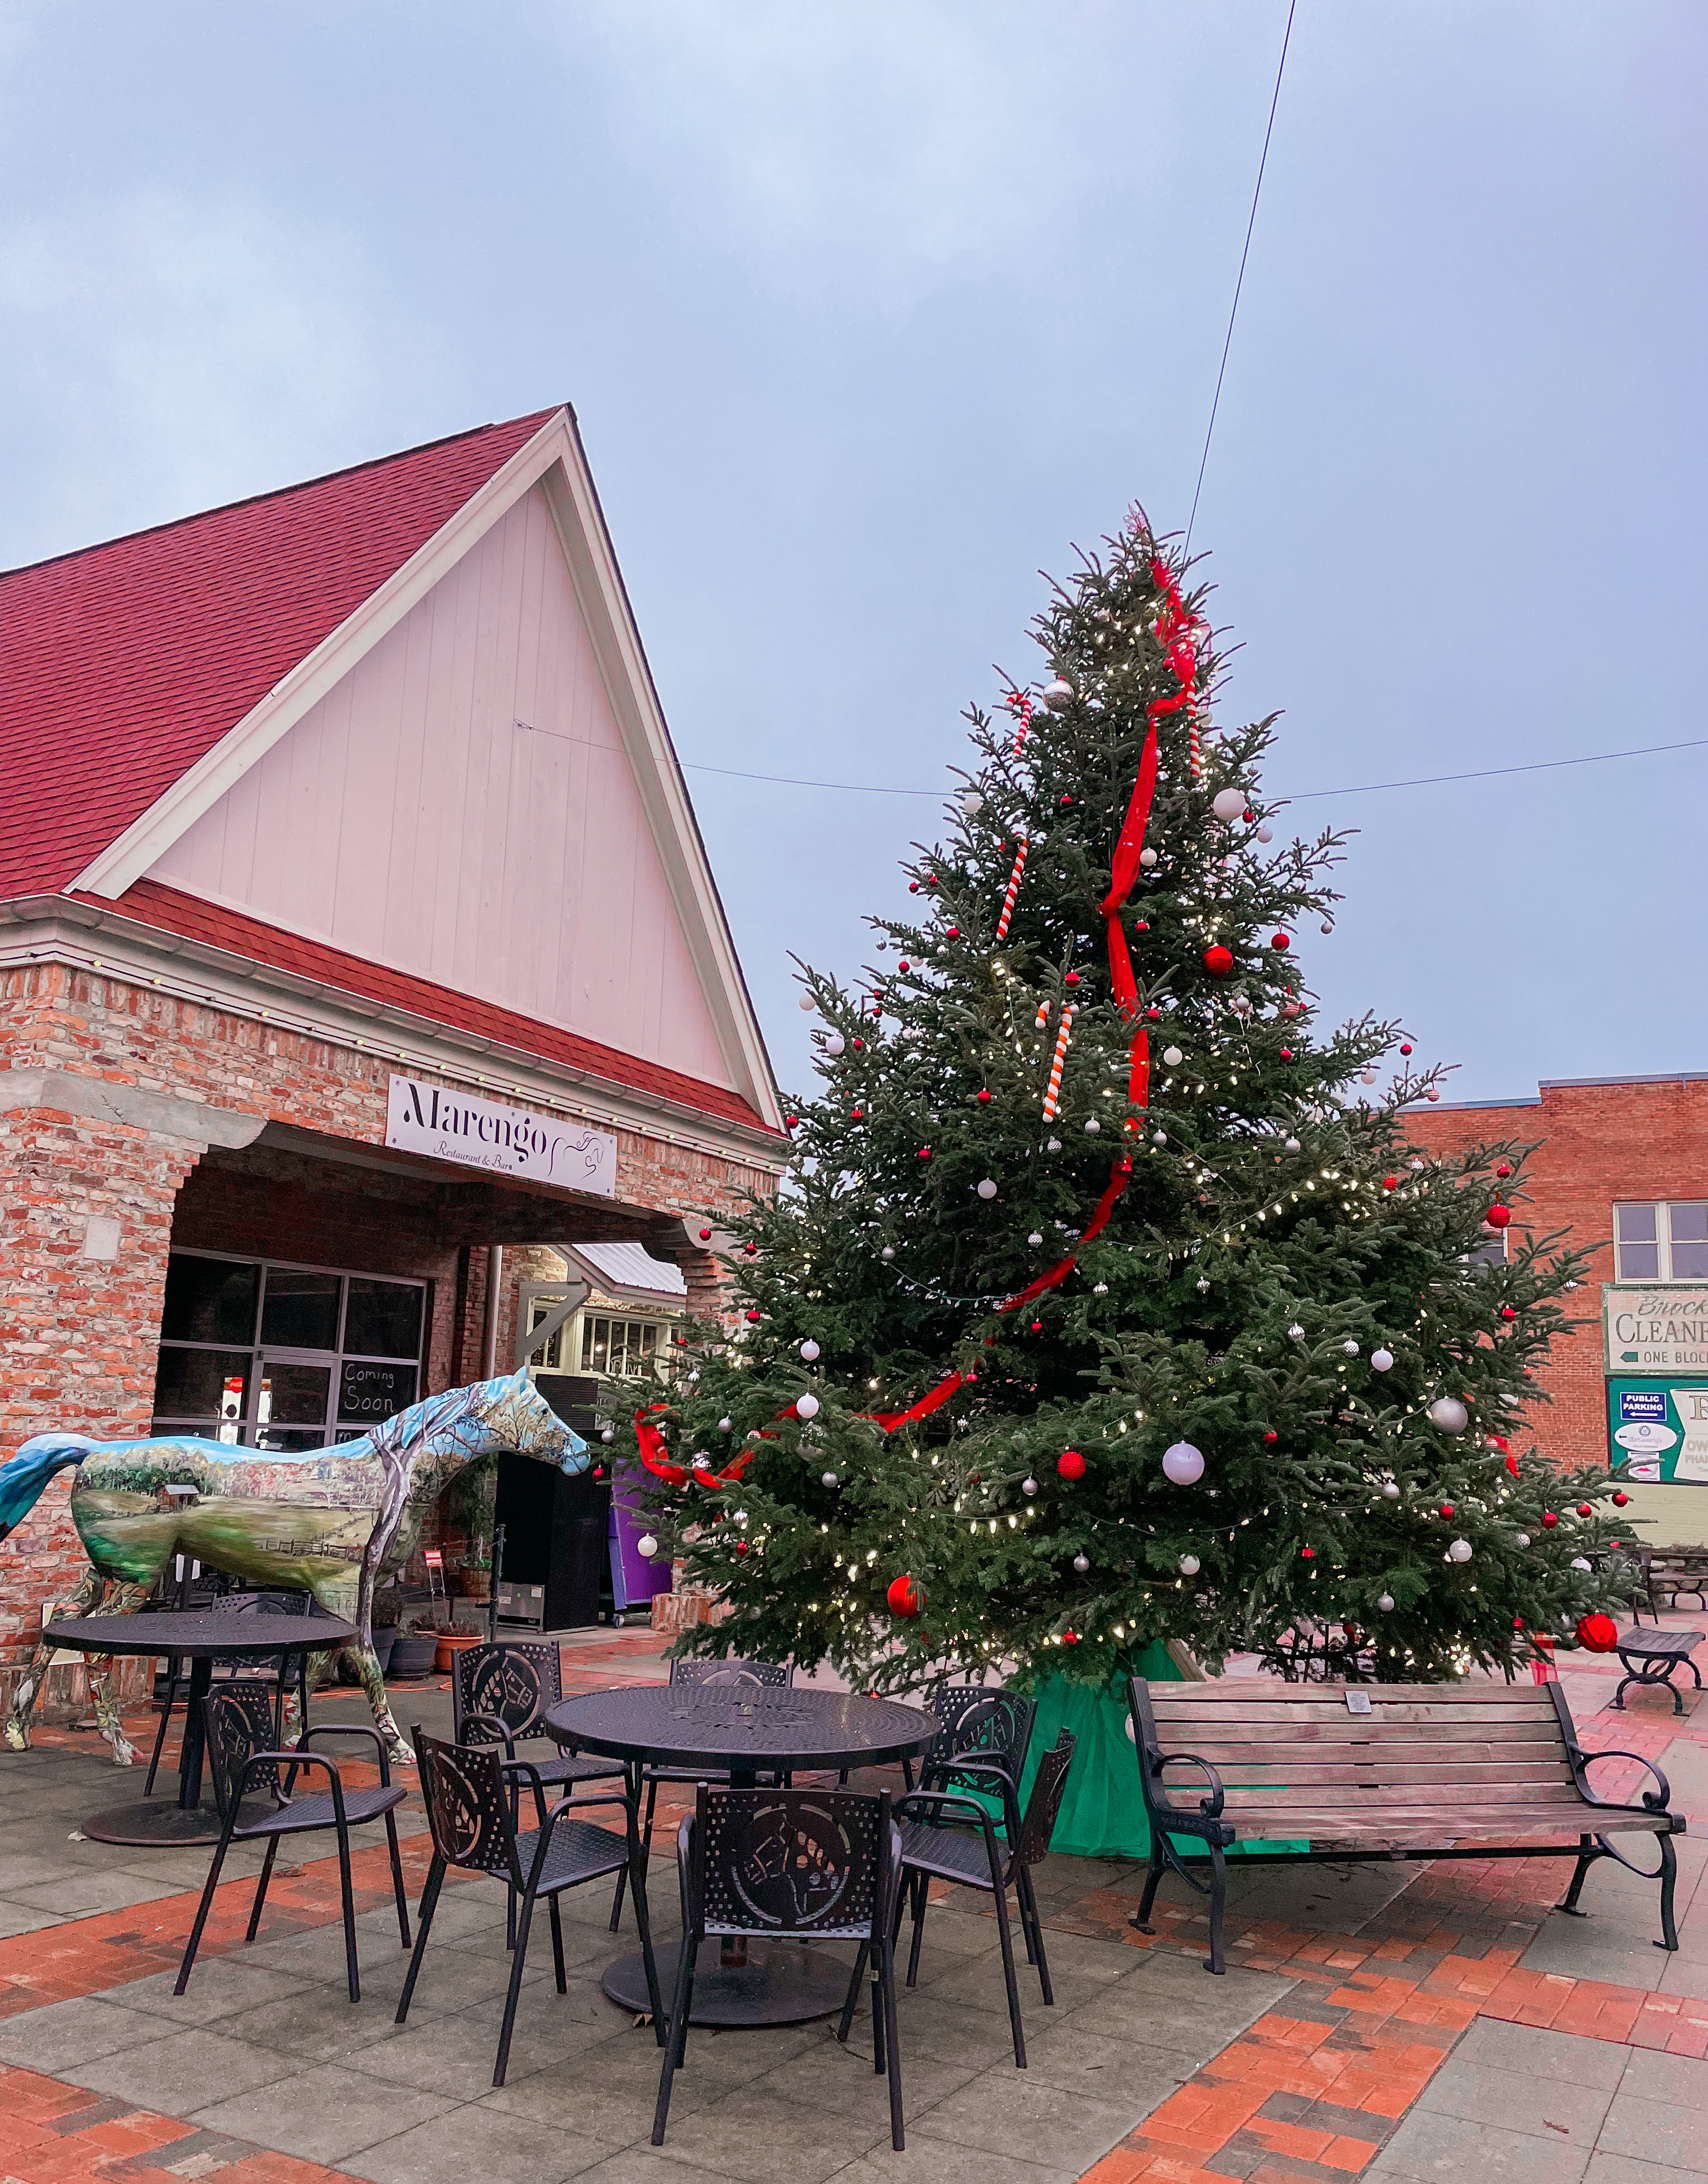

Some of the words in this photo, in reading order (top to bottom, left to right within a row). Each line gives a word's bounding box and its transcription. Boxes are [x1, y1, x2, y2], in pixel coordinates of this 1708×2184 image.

[403, 1083, 546, 1162] Marengo
[434, 1141, 480, 1163] Restaurant
[481, 1155, 490, 1166] &
[492, 1154, 508, 1169] Bar
[1644, 1351, 1669, 1363] ONE
[345, 1364, 394, 1388] Coming
[344, 1386, 394, 1412] Soon
